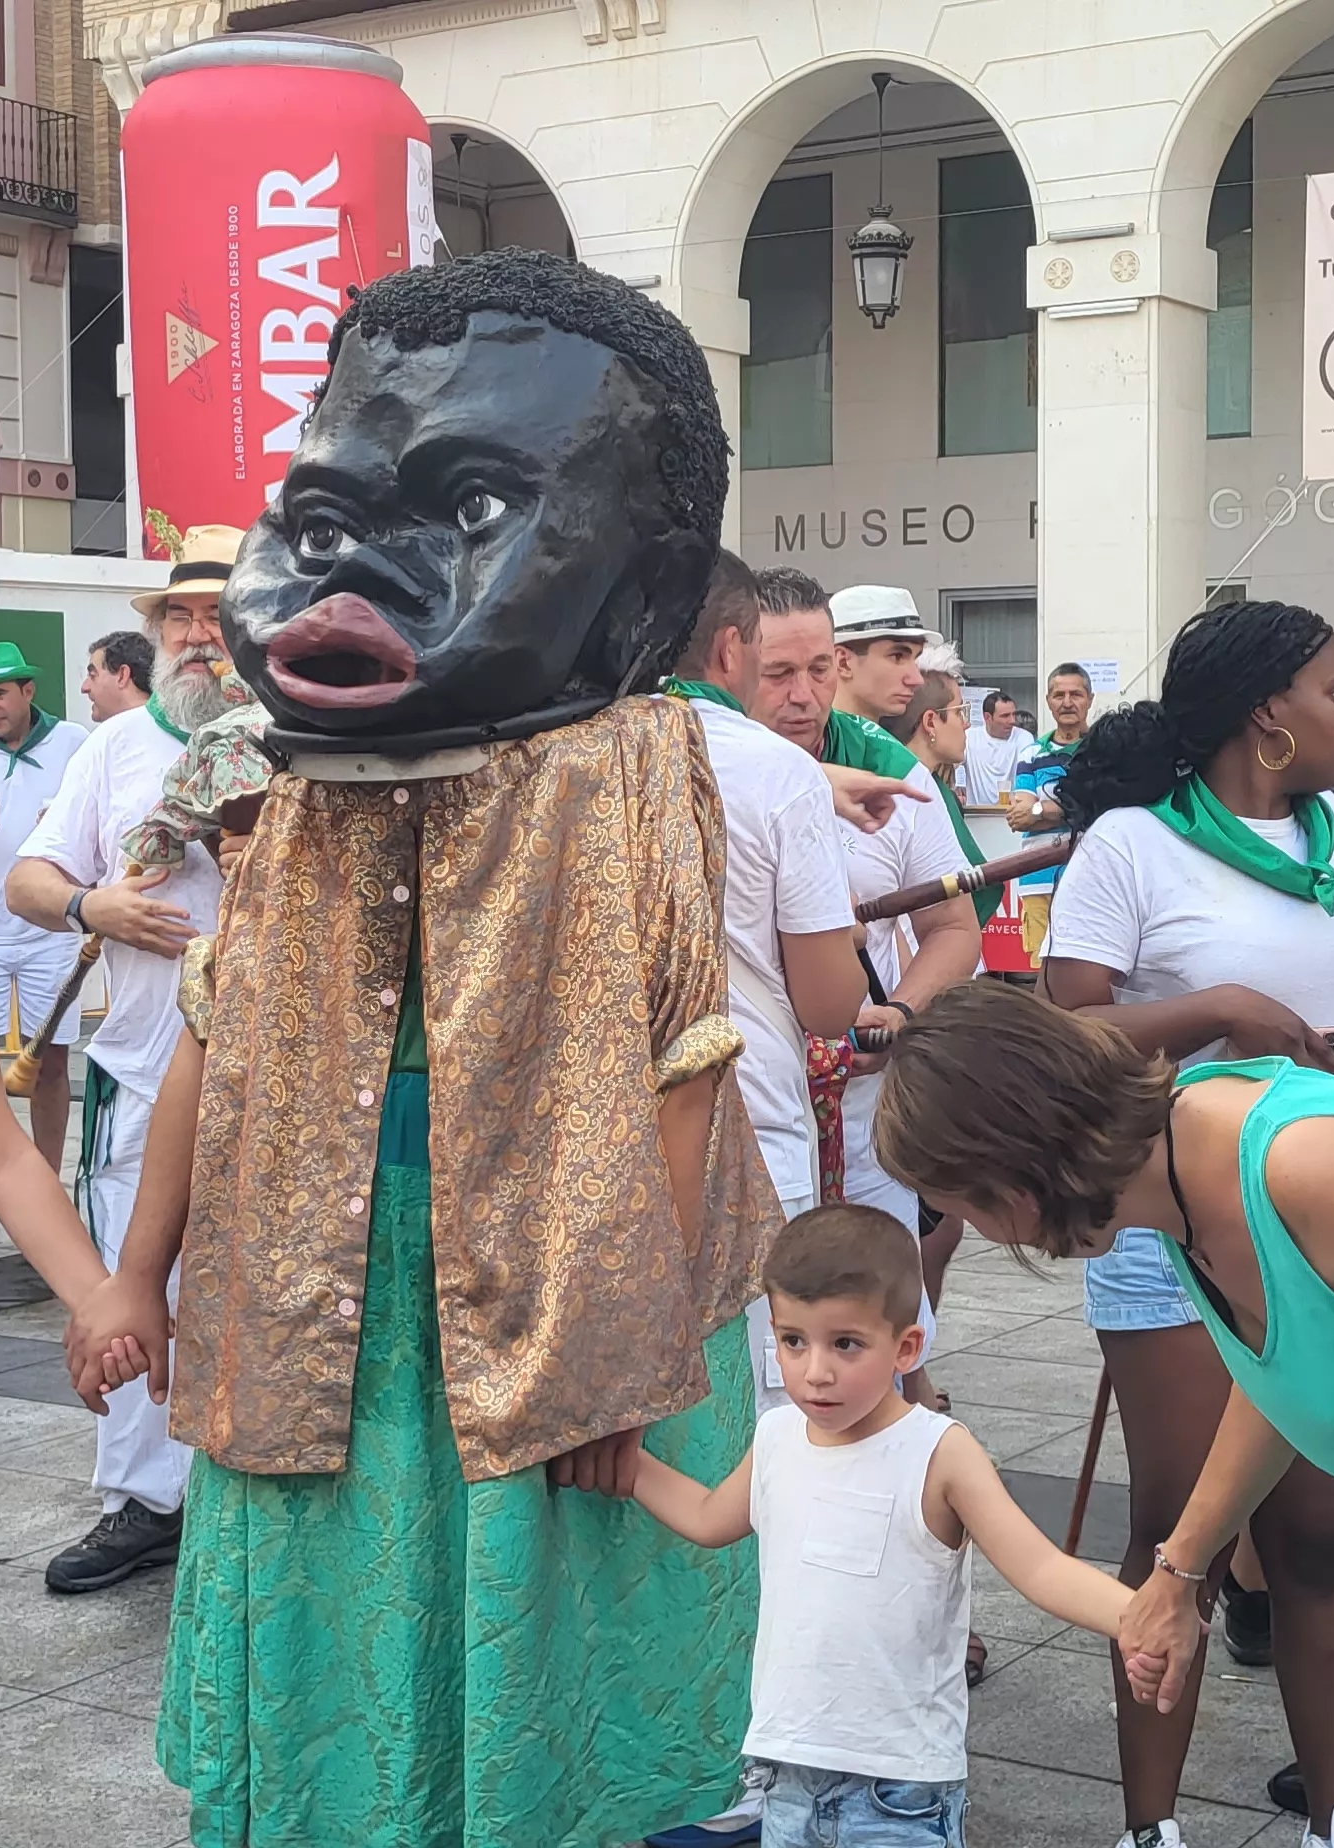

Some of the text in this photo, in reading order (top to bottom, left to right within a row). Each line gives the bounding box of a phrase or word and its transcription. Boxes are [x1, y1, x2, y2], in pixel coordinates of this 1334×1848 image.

[169, 323, 179, 370] 1900
[227, 205, 245, 480] ELABORADA EN ZARAGOZA DESDE 1900
[256, 151, 340, 502] MBAR
[774, 504, 976, 552] MUSEO
